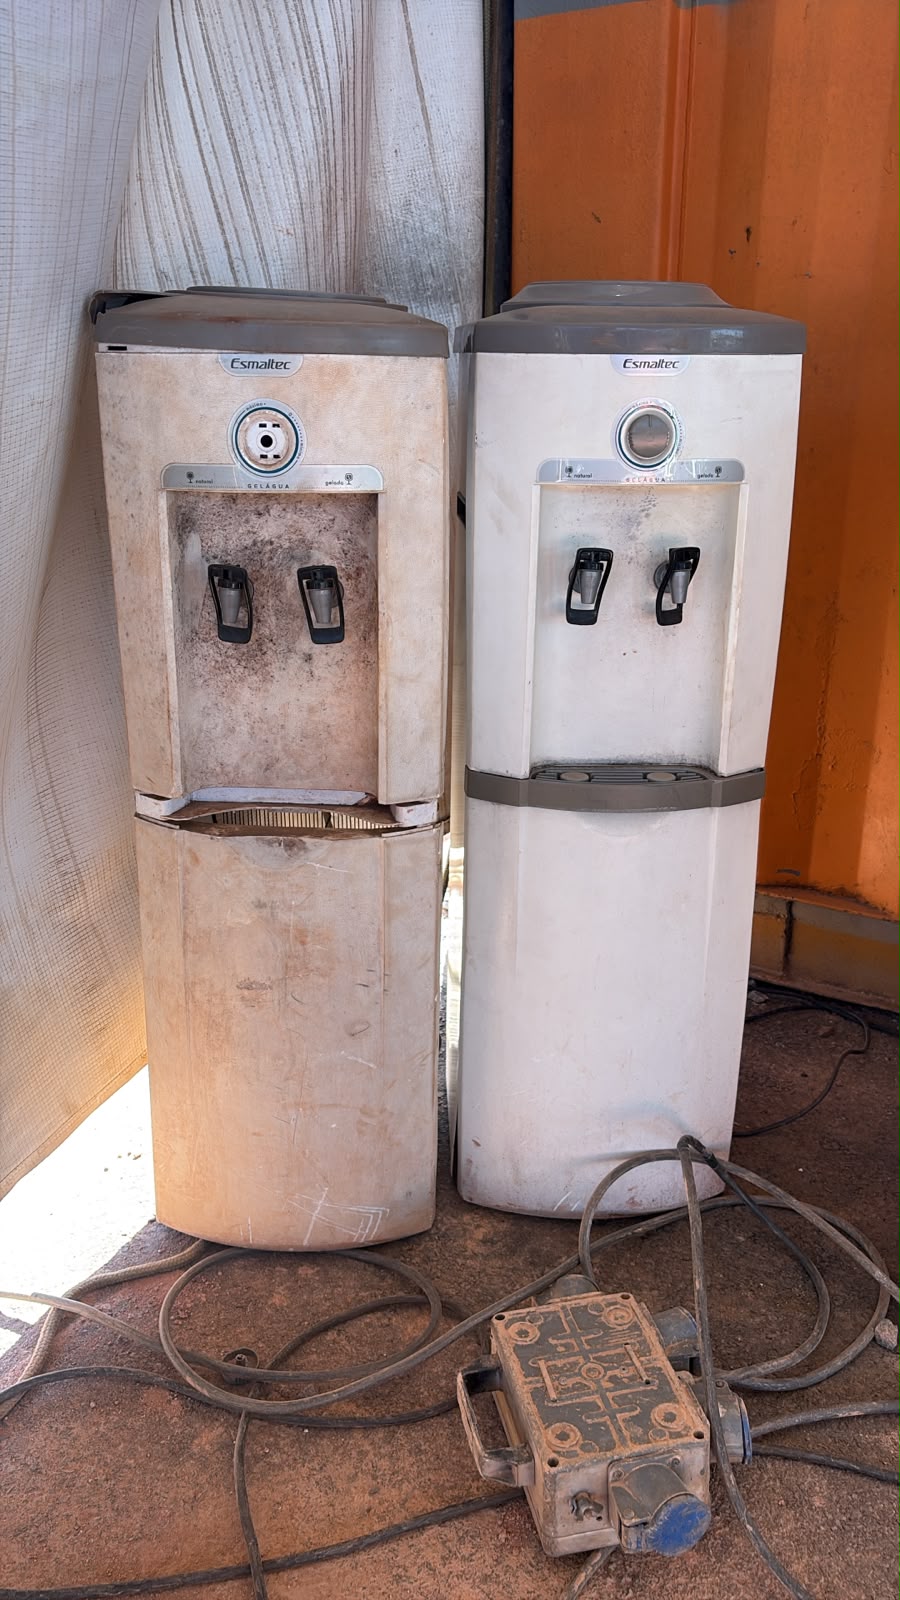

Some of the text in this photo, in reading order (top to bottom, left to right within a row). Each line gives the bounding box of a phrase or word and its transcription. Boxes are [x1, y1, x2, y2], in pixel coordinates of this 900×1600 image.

[230, 357, 292, 371] Esmaltec
[622, 357, 681, 370] Esmaltec
[573, 472, 594, 480] natural
[247, 482, 291, 490] GELÁGUA
[325, 479, 345, 487] gelado
